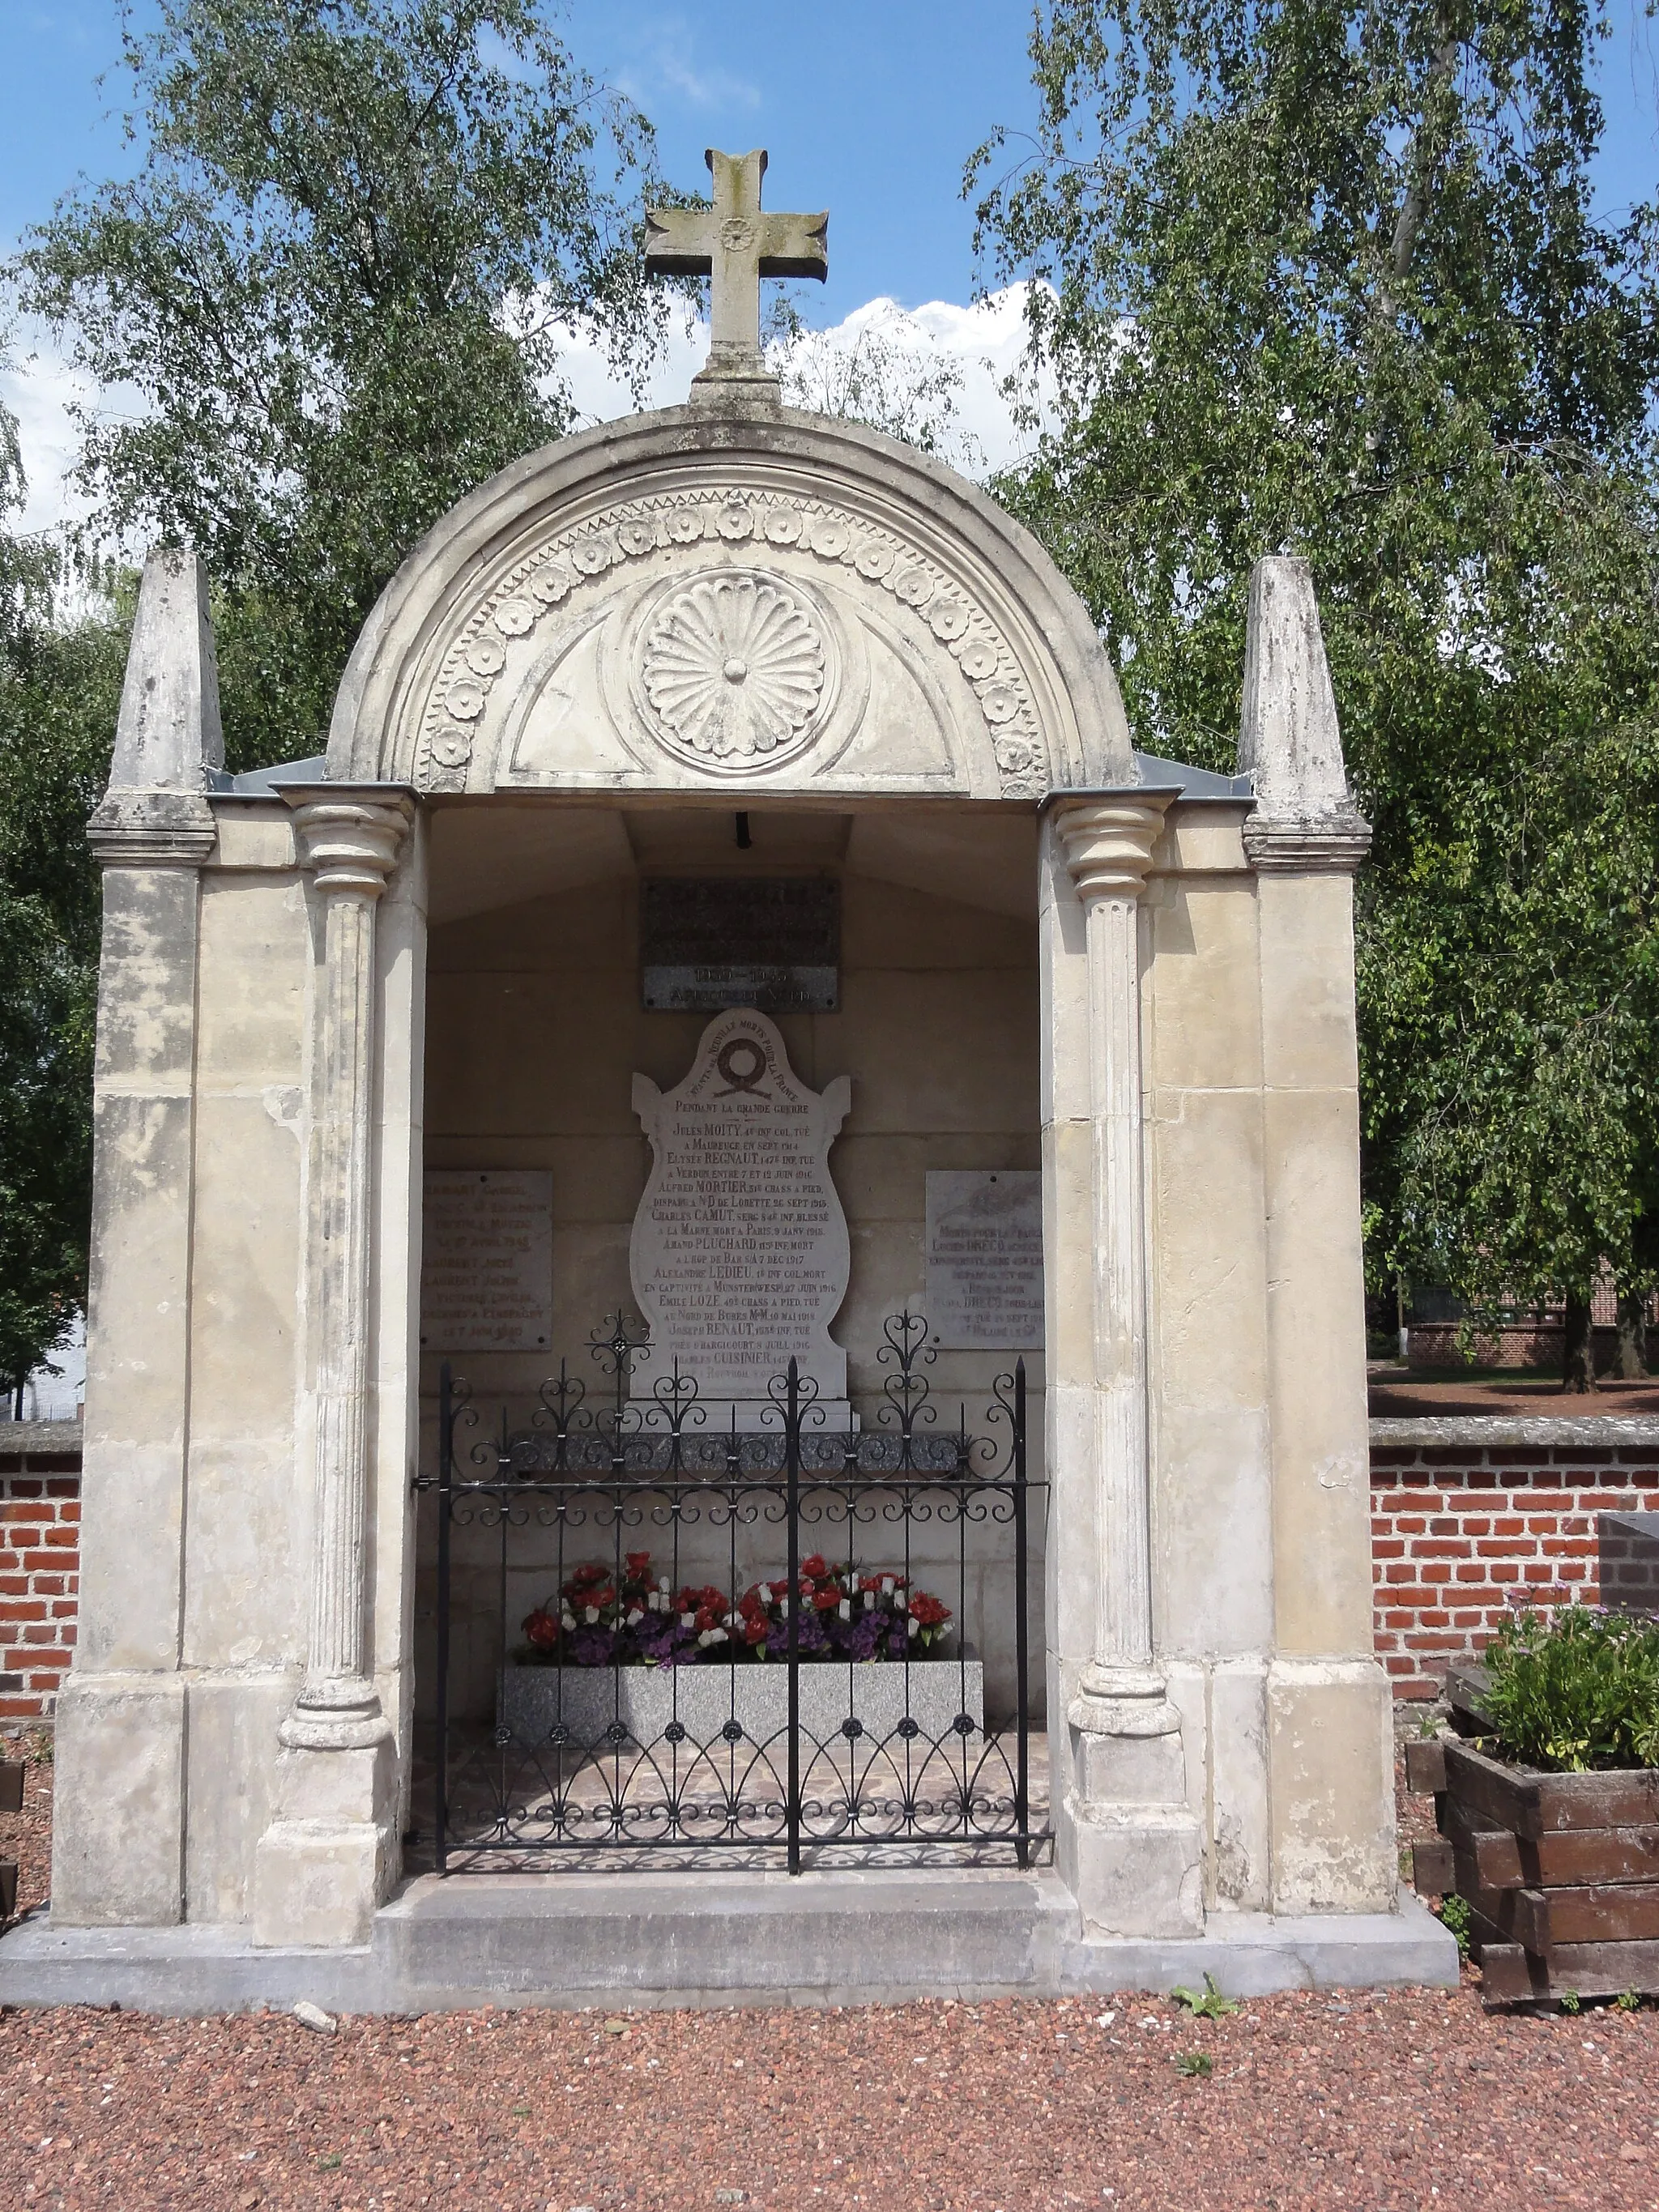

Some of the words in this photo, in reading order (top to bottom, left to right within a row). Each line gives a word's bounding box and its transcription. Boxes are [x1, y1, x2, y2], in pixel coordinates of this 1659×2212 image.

[708, 1021, 736, 1057] NEUVILLE
[739, 1020, 766, 1039] MORTS
[763, 1039, 776, 1063] POUR
[774, 1073, 800, 1102] FRANCE
[676, 1100, 718, 1113] PENDANT
[723, 1104, 733, 1113] LA
[737, 1104, 770, 1114] GRANDE
[774, 1104, 809, 1115] GUERRE
[673, 1123, 702, 1136] JULES
[744, 1142, 754, 1150] EN
[713, 1170, 739, 1178] ENTRE
[741, 1170, 748, 1178] 7
[749, 1170, 761, 1178] ET
[774, 1170, 793, 1179] JUIN
[658, 1183, 694, 1192] ALFRED
[718, 1199, 729, 1207] DE
[731, 1196, 771, 1208] LORETTE
[787, 1199, 808, 1208] SEPT
[652, 1208, 692, 1221] CHARLES
[667, 1227, 678, 1235] LA
[791, 1242, 815, 1250] MORT
[710, 1255, 722, 1264] DE
[723, 1252, 743, 1264] BAR
[760, 1255, 766, 1264] 7
[787, 1255, 805, 1264] 1917
[654, 1267, 706, 1278] ALEXANDRE
[803, 1270, 827, 1278] MORT
[645, 1283, 655, 1292] EN
[799, 1284, 817, 1293] JUIN
[819, 1284, 837, 1293] 1916
[659, 1295, 688, 1306] EMILE
[678, 1309, 702, 1321] NORD
[704, 1312, 715, 1320] DE
[782, 1312, 796, 1320] MAI
[669, 1323, 704, 1336] JOSEPH
